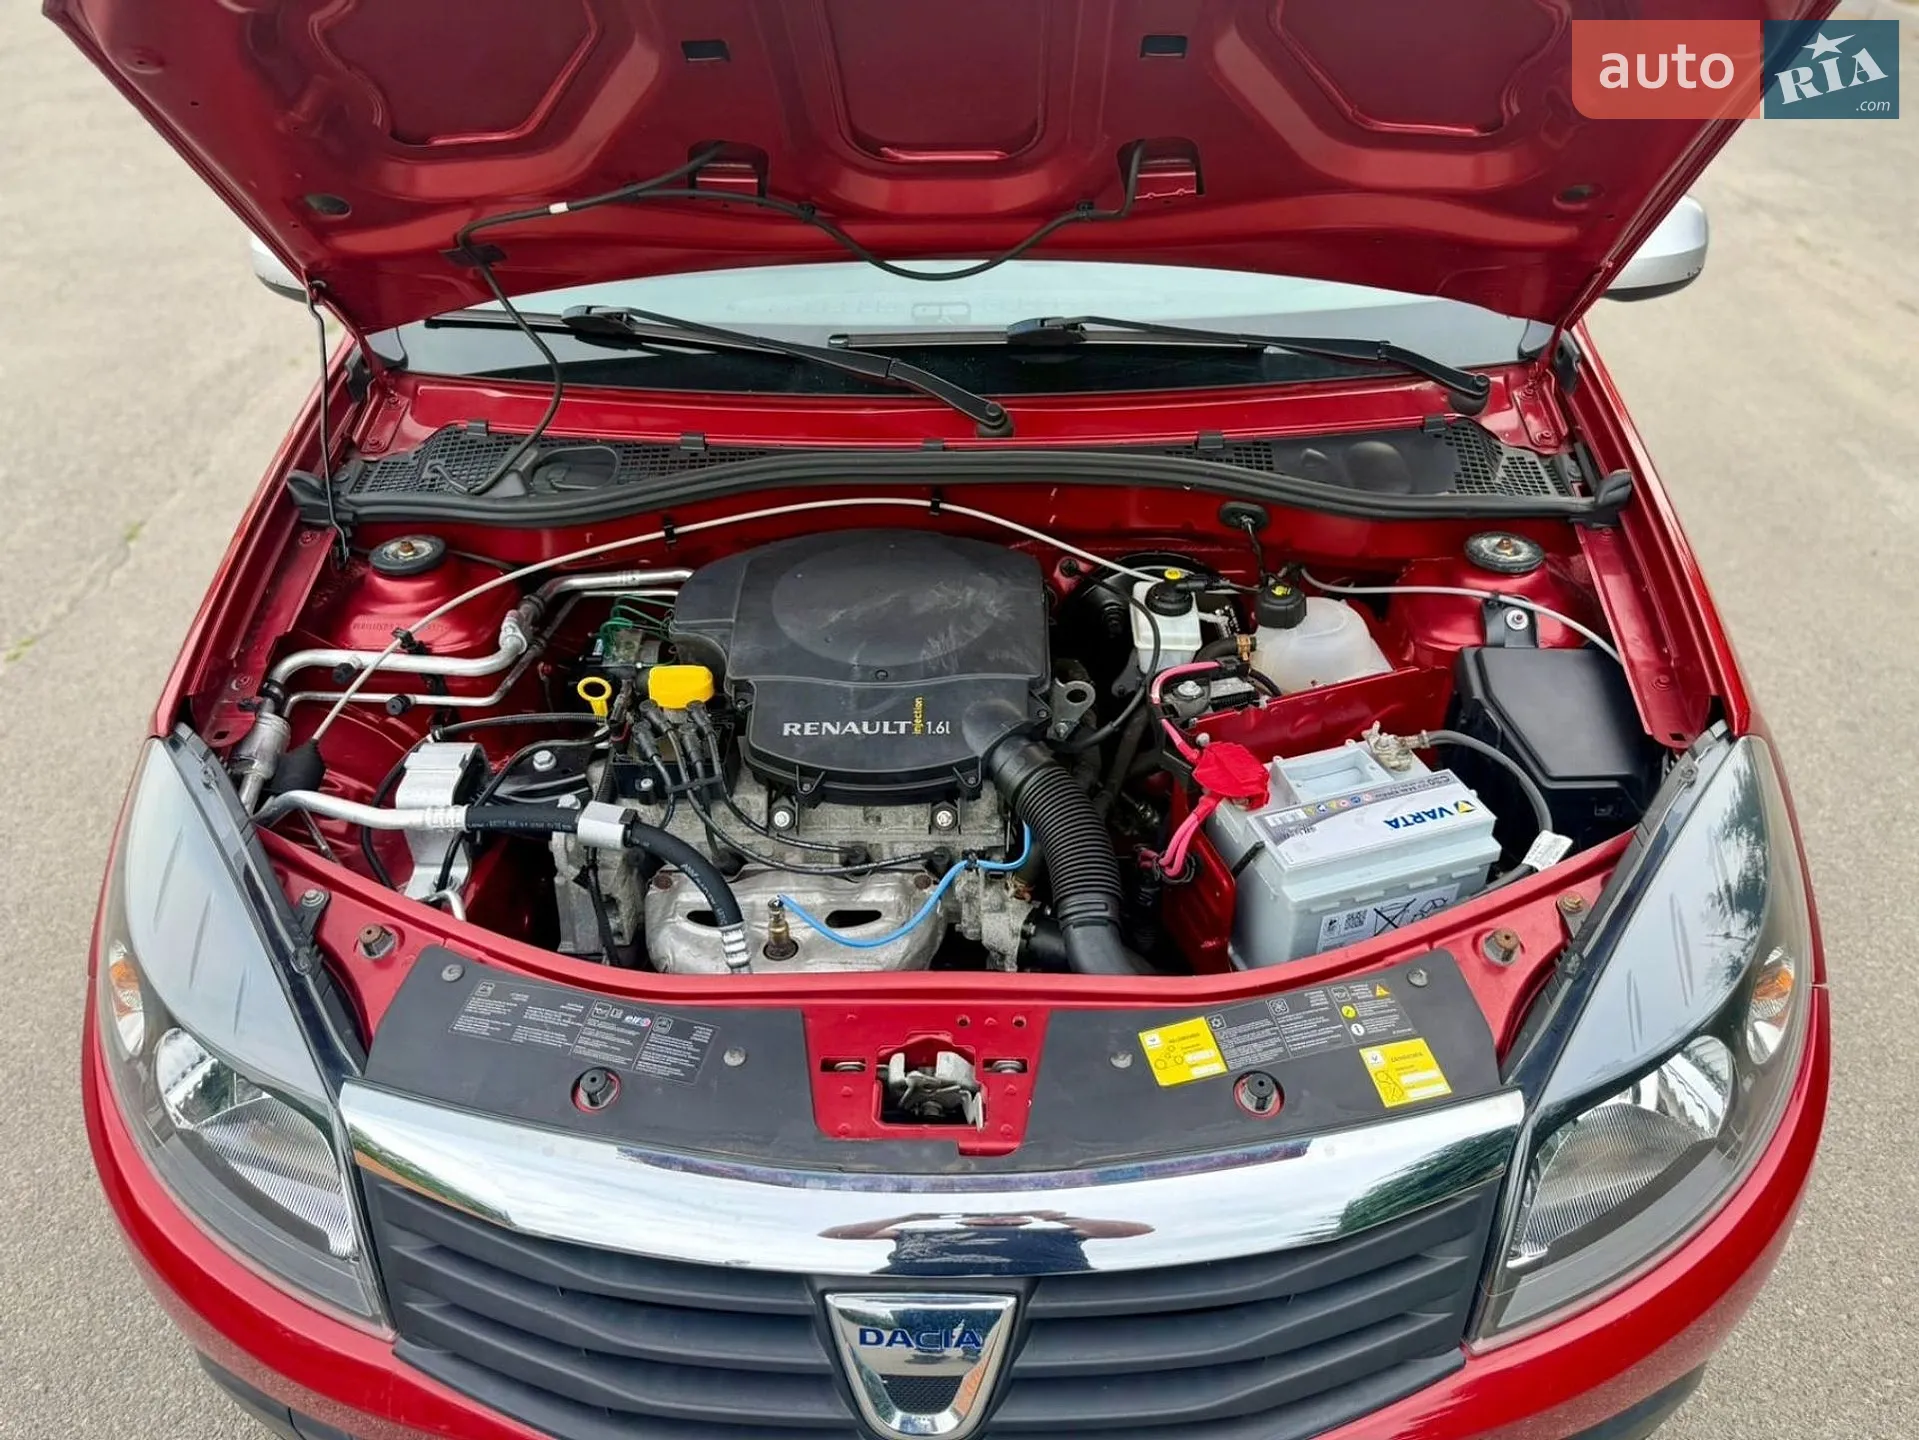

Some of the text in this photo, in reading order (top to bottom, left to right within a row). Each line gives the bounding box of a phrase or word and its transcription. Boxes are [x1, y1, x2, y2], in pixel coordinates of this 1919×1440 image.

[782, 720, 912, 736] RENAULT
[1383, 806, 1454, 829] VARTA
[858, 1327, 983, 1350] DACIA
